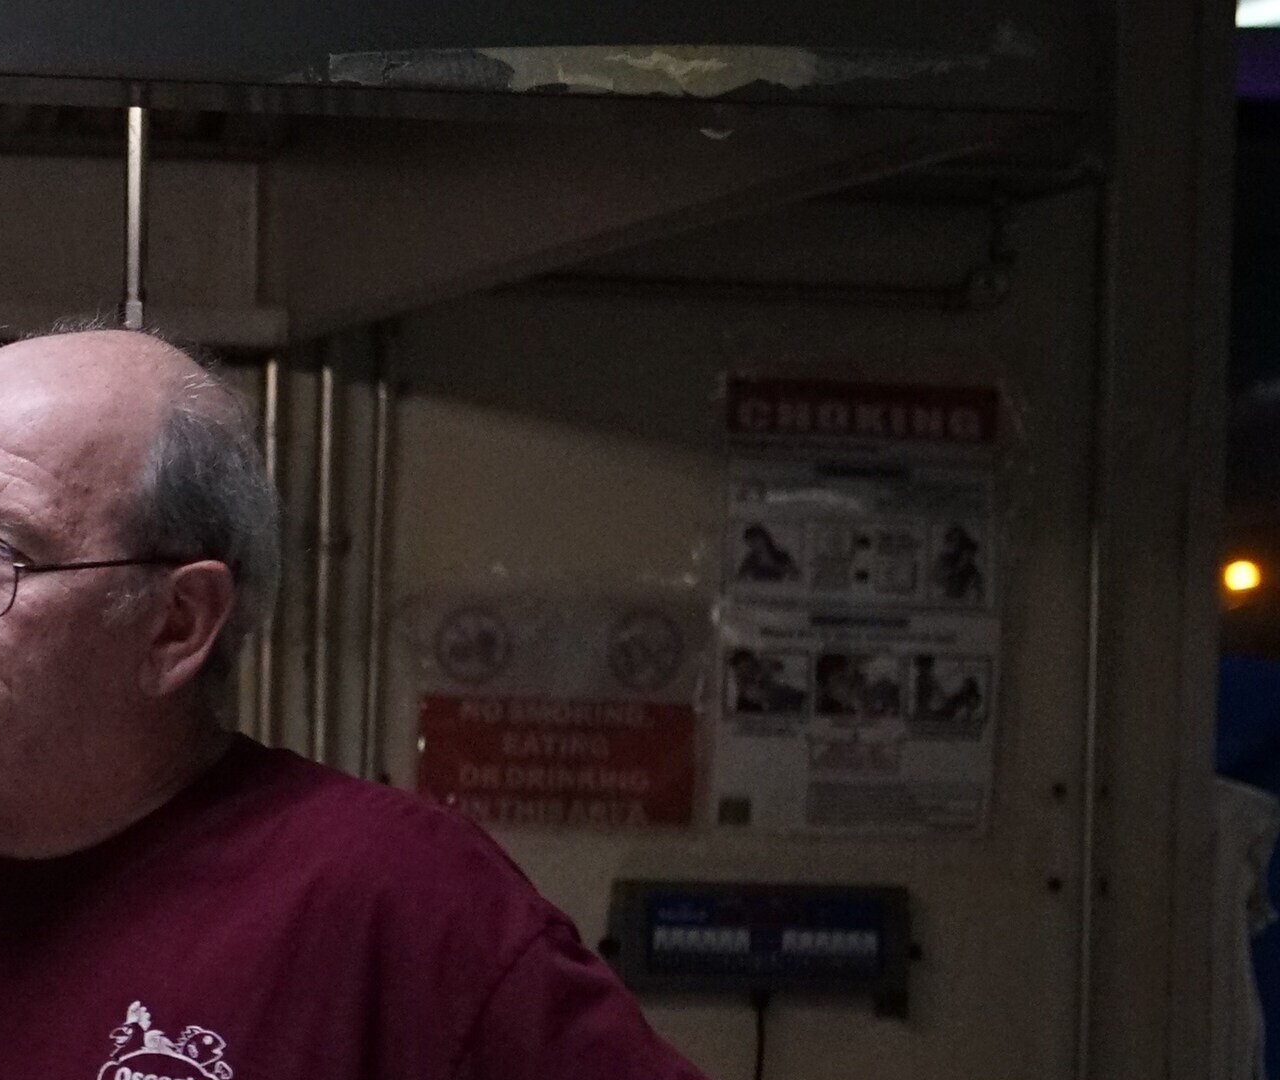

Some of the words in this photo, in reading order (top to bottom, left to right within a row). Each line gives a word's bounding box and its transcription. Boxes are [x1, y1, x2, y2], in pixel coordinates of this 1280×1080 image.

[737, 398, 981, 435] CHOKING
[459, 698, 502, 724] NO
[501, 729, 610, 758] EATING
[459, 762, 500, 790] OR
[505, 763, 650, 794] DRINKING
